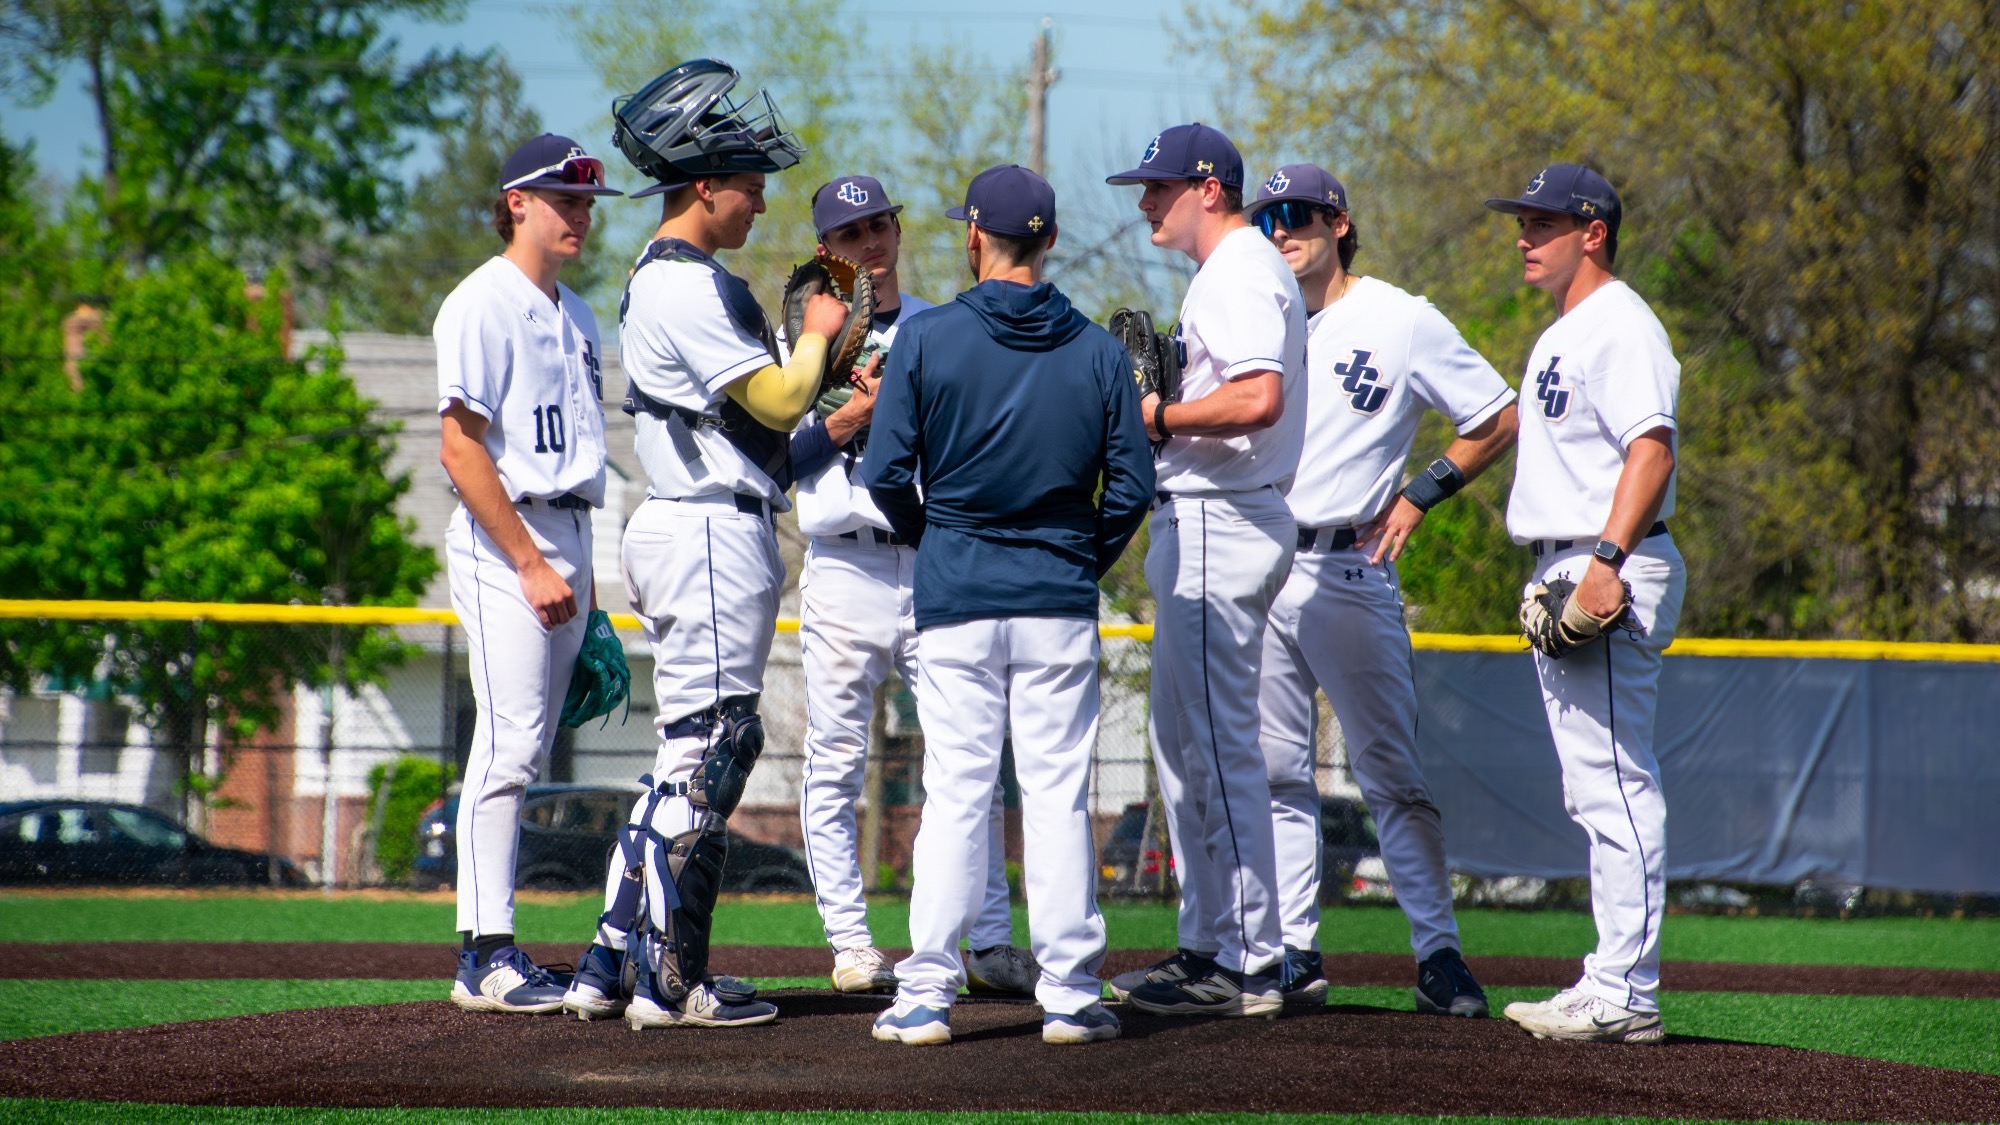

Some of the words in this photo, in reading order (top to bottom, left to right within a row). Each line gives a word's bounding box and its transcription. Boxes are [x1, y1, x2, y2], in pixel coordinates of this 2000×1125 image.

[837, 181, 869, 207] JCU
[1331, 347, 1392, 417] JCU
[1536, 354, 1574, 422] JCU
[533, 404, 566, 453] 10
